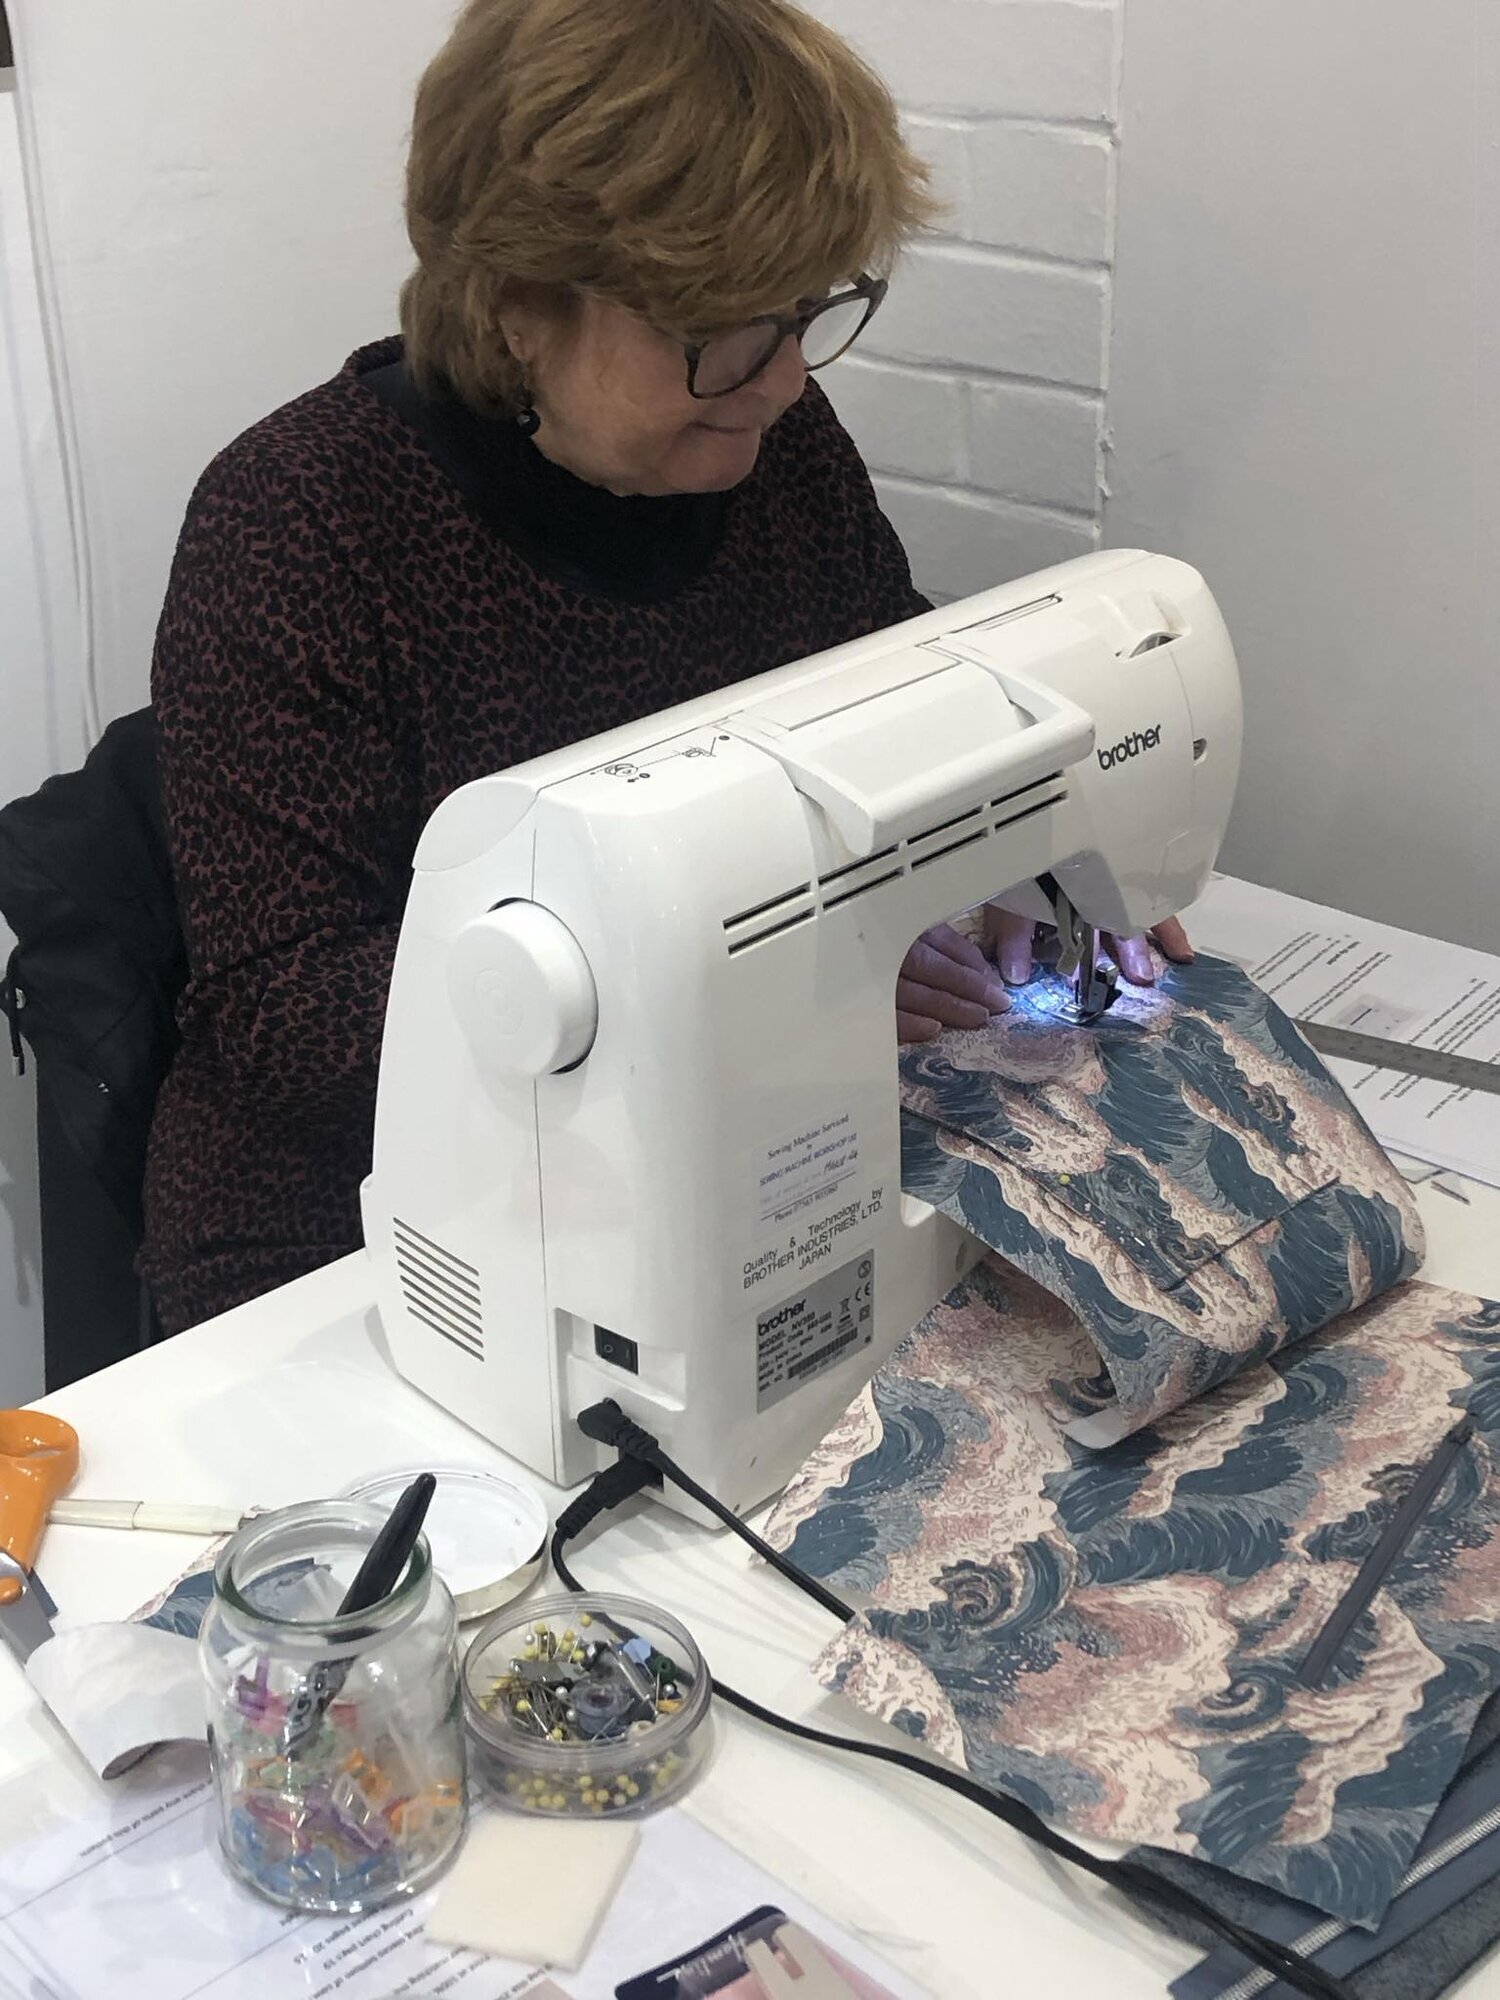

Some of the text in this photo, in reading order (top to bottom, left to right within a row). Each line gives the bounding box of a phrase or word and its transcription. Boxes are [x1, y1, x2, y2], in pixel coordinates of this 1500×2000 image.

[1097, 724, 1161, 770] brother
[793, 1129, 820, 1147] Machine
[743, 1186, 883, 1275] Quality & Technology by
[743, 1250, 795, 1289] BROTHER
[861, 1200, 883, 1220] LTD.
[799, 1243, 832, 1270] JAPAN
[758, 1298, 807, 1337] brother
[759, 1329, 786, 1351] MODEL
